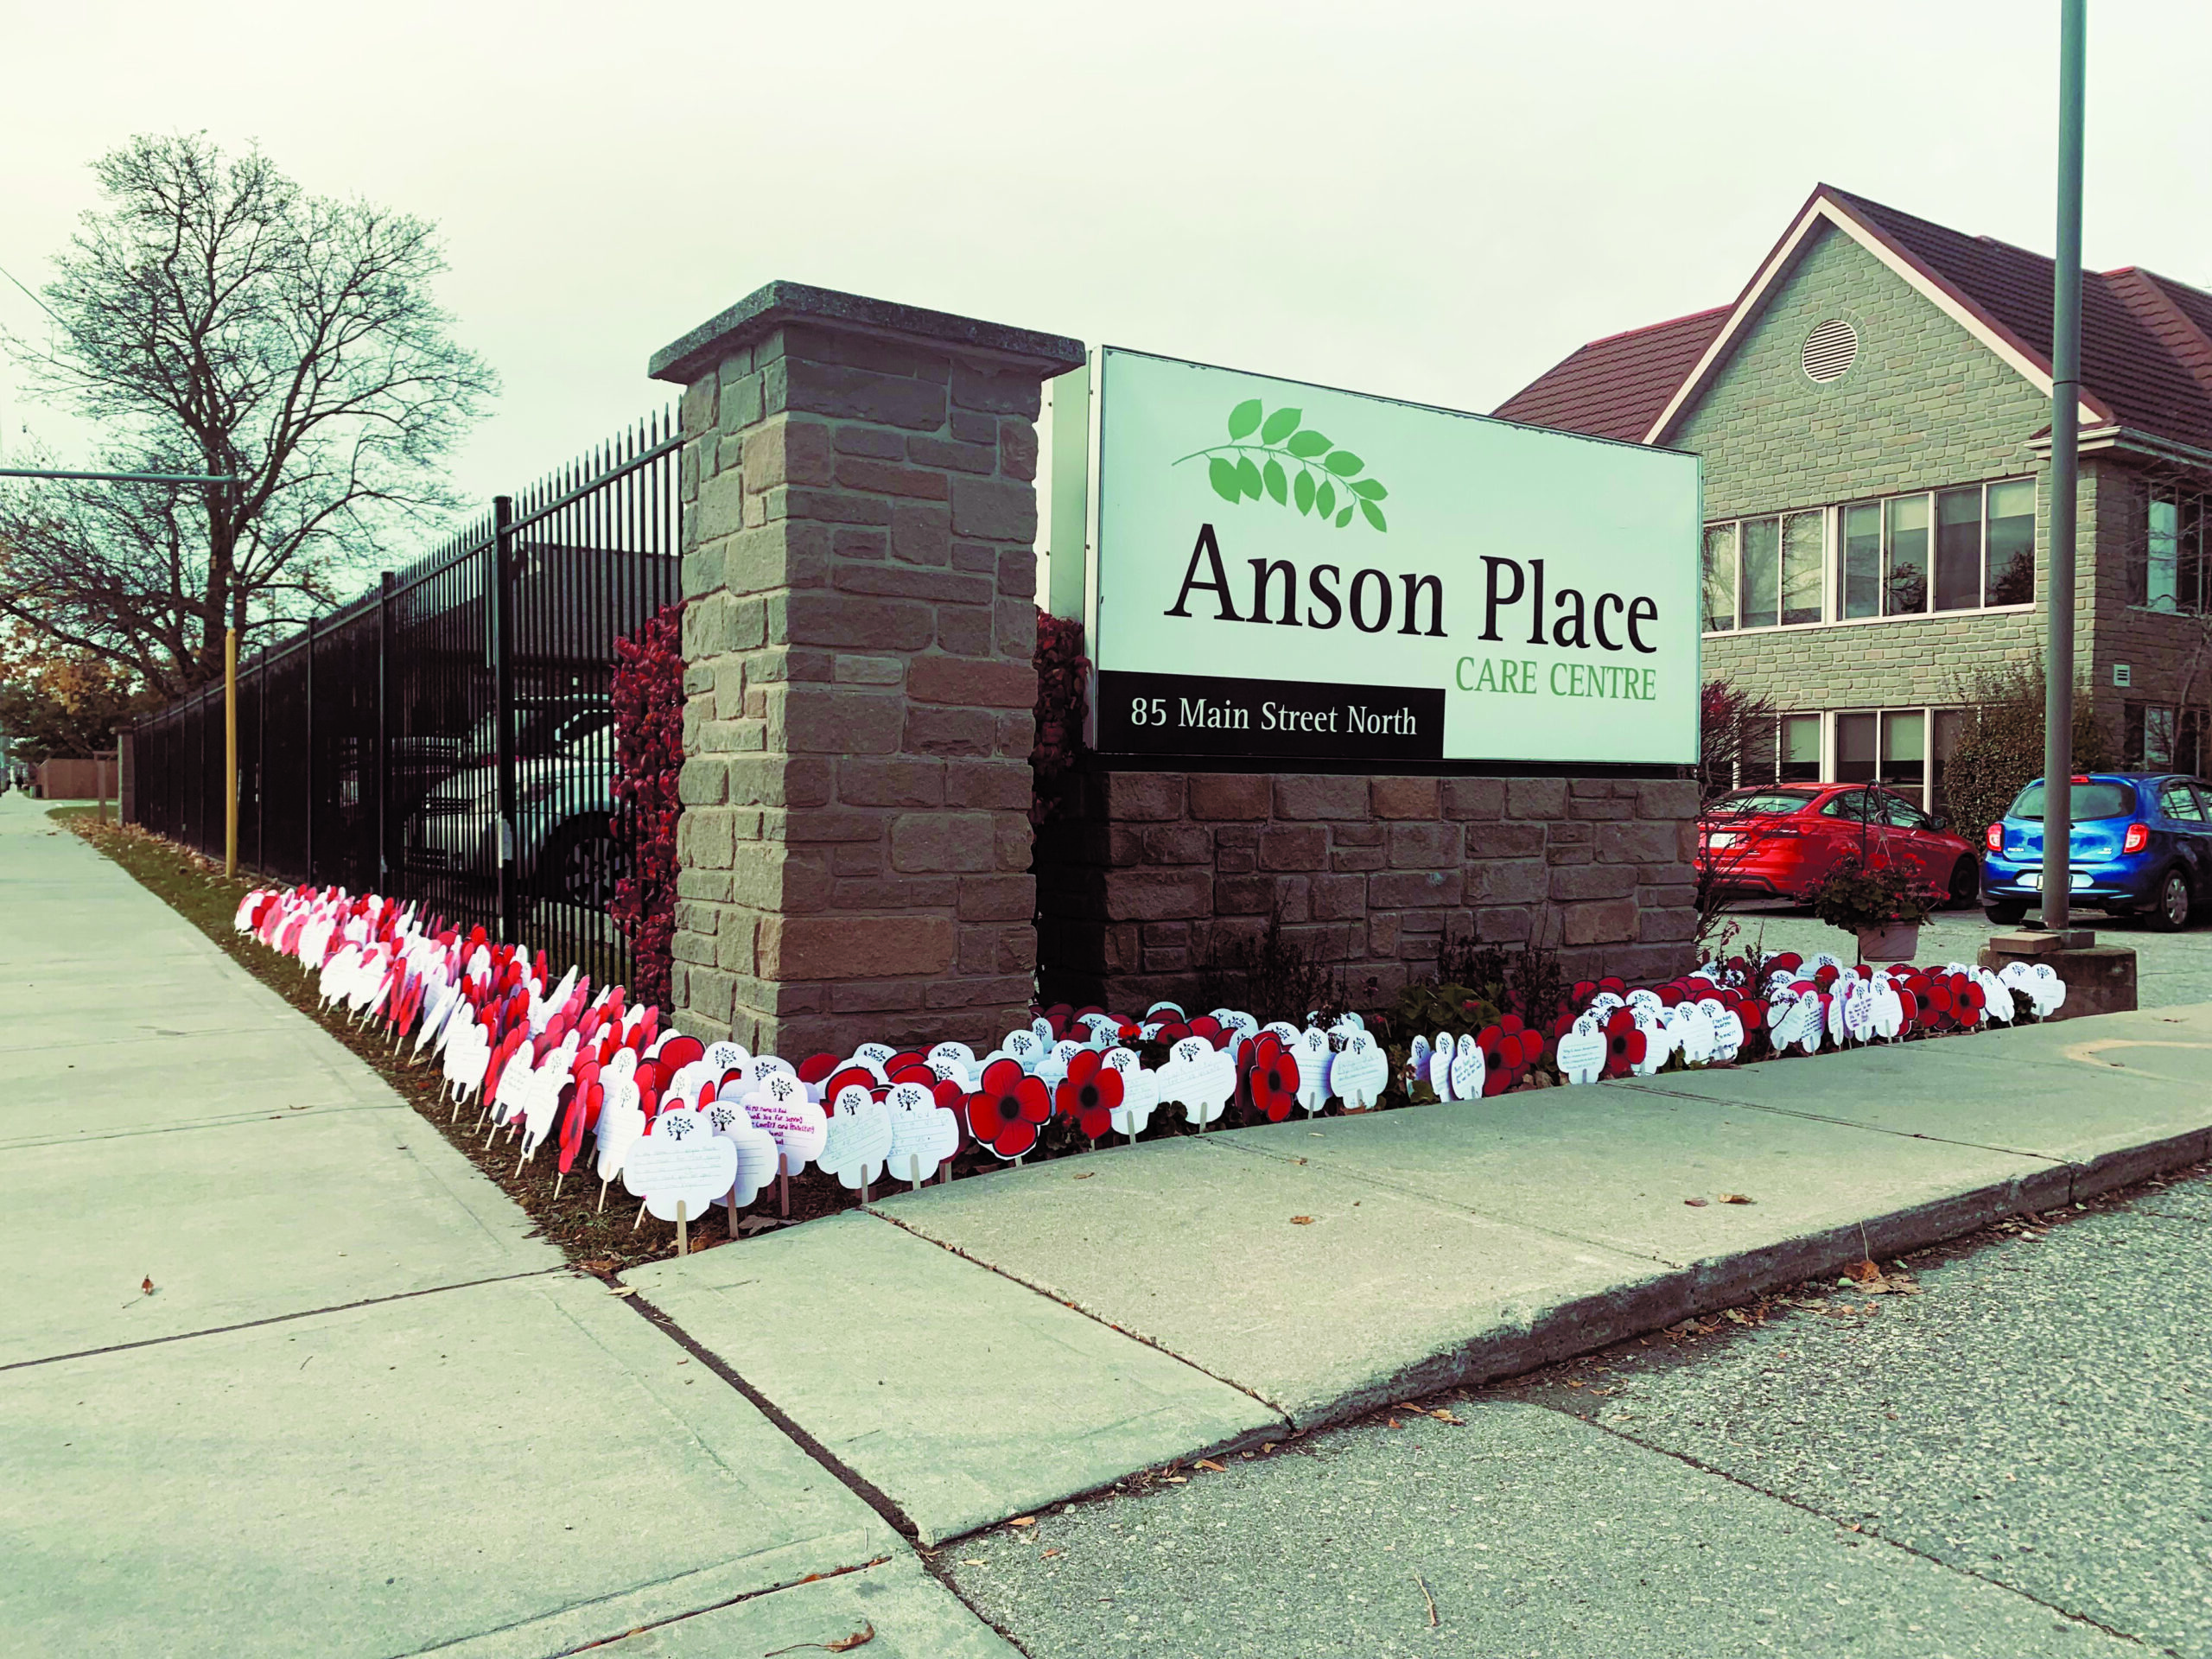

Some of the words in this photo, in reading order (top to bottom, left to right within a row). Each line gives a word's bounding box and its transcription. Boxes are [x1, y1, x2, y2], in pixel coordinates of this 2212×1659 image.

[1164, 524, 1447, 638] Anson
[1478, 556, 1658, 653] Place
[1456, 657, 1537, 695] CARE
[1550, 663, 1656, 701] CENTRE
[1131, 697, 1166, 726] 85
[1178, 697, 1250, 729] Main
[1261, 702, 1338, 733] Street
[1346, 705, 1417, 735] North
